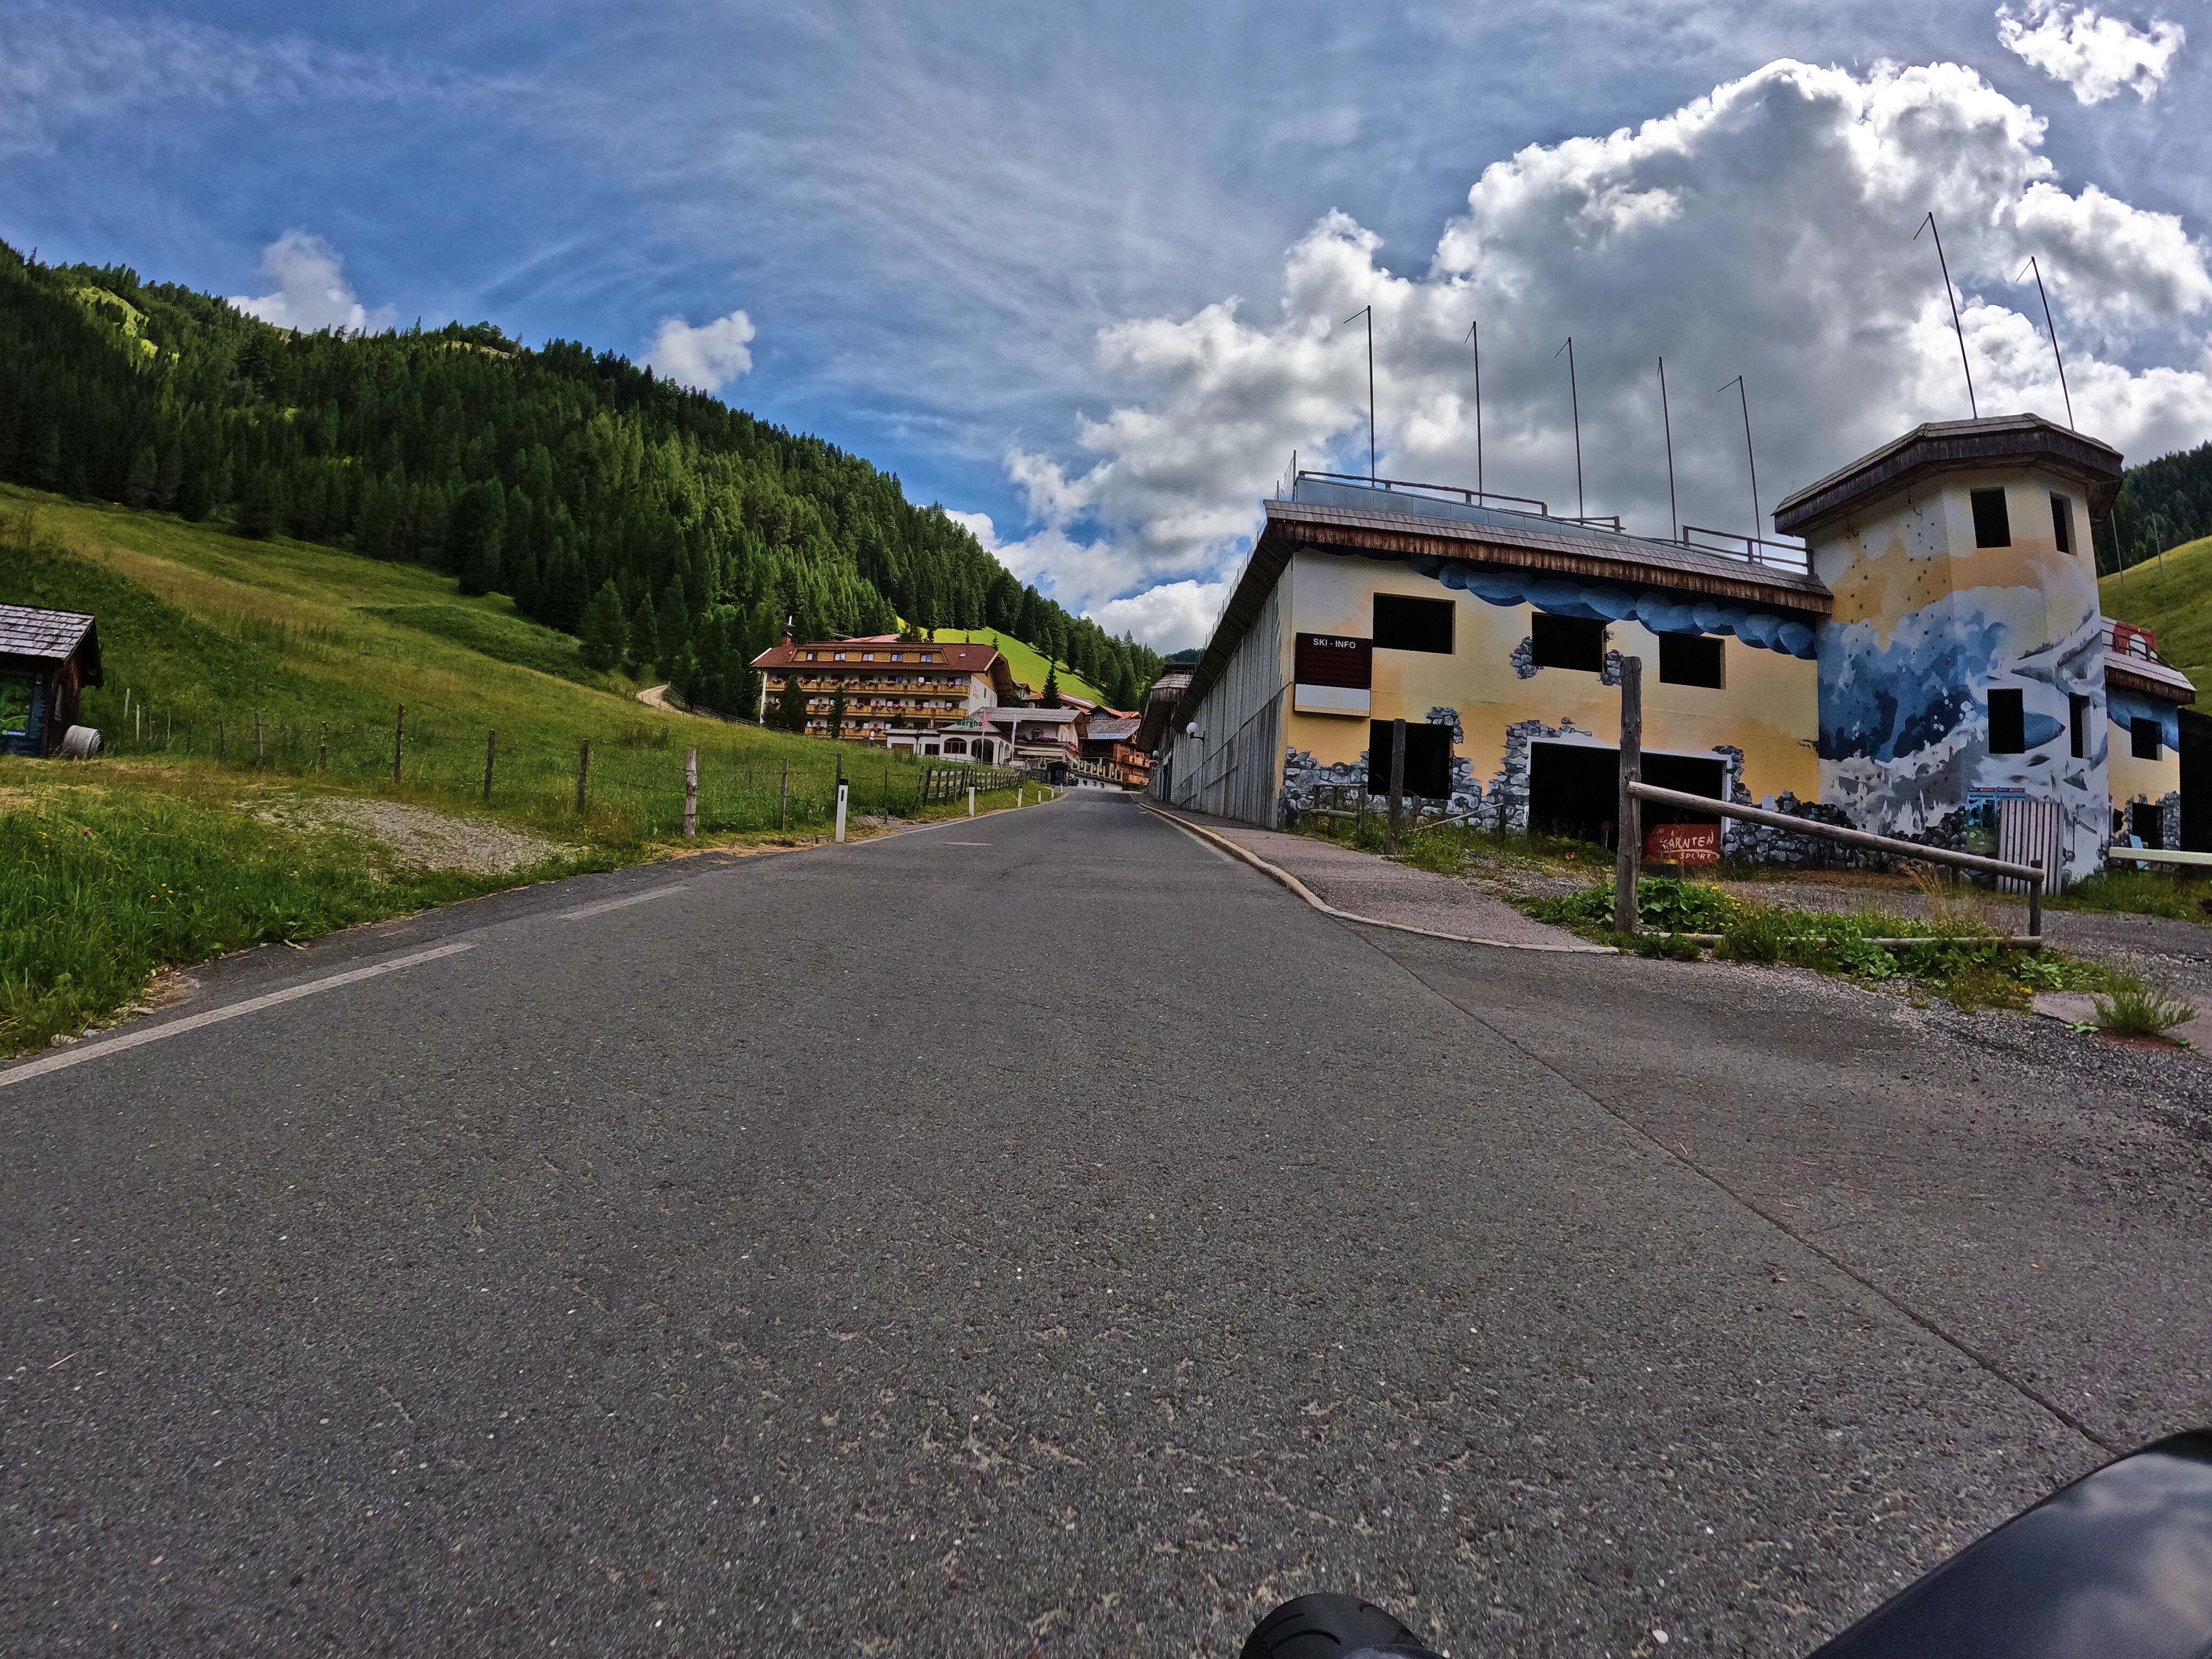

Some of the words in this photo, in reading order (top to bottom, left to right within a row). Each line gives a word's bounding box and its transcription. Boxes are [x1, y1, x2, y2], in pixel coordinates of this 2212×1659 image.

[1313, 638, 1327, 646] SKI
[1335, 640, 1356, 649] INFO
[956, 720, 984, 728] Bergho
[1680, 851, 1711, 860] SPORT
